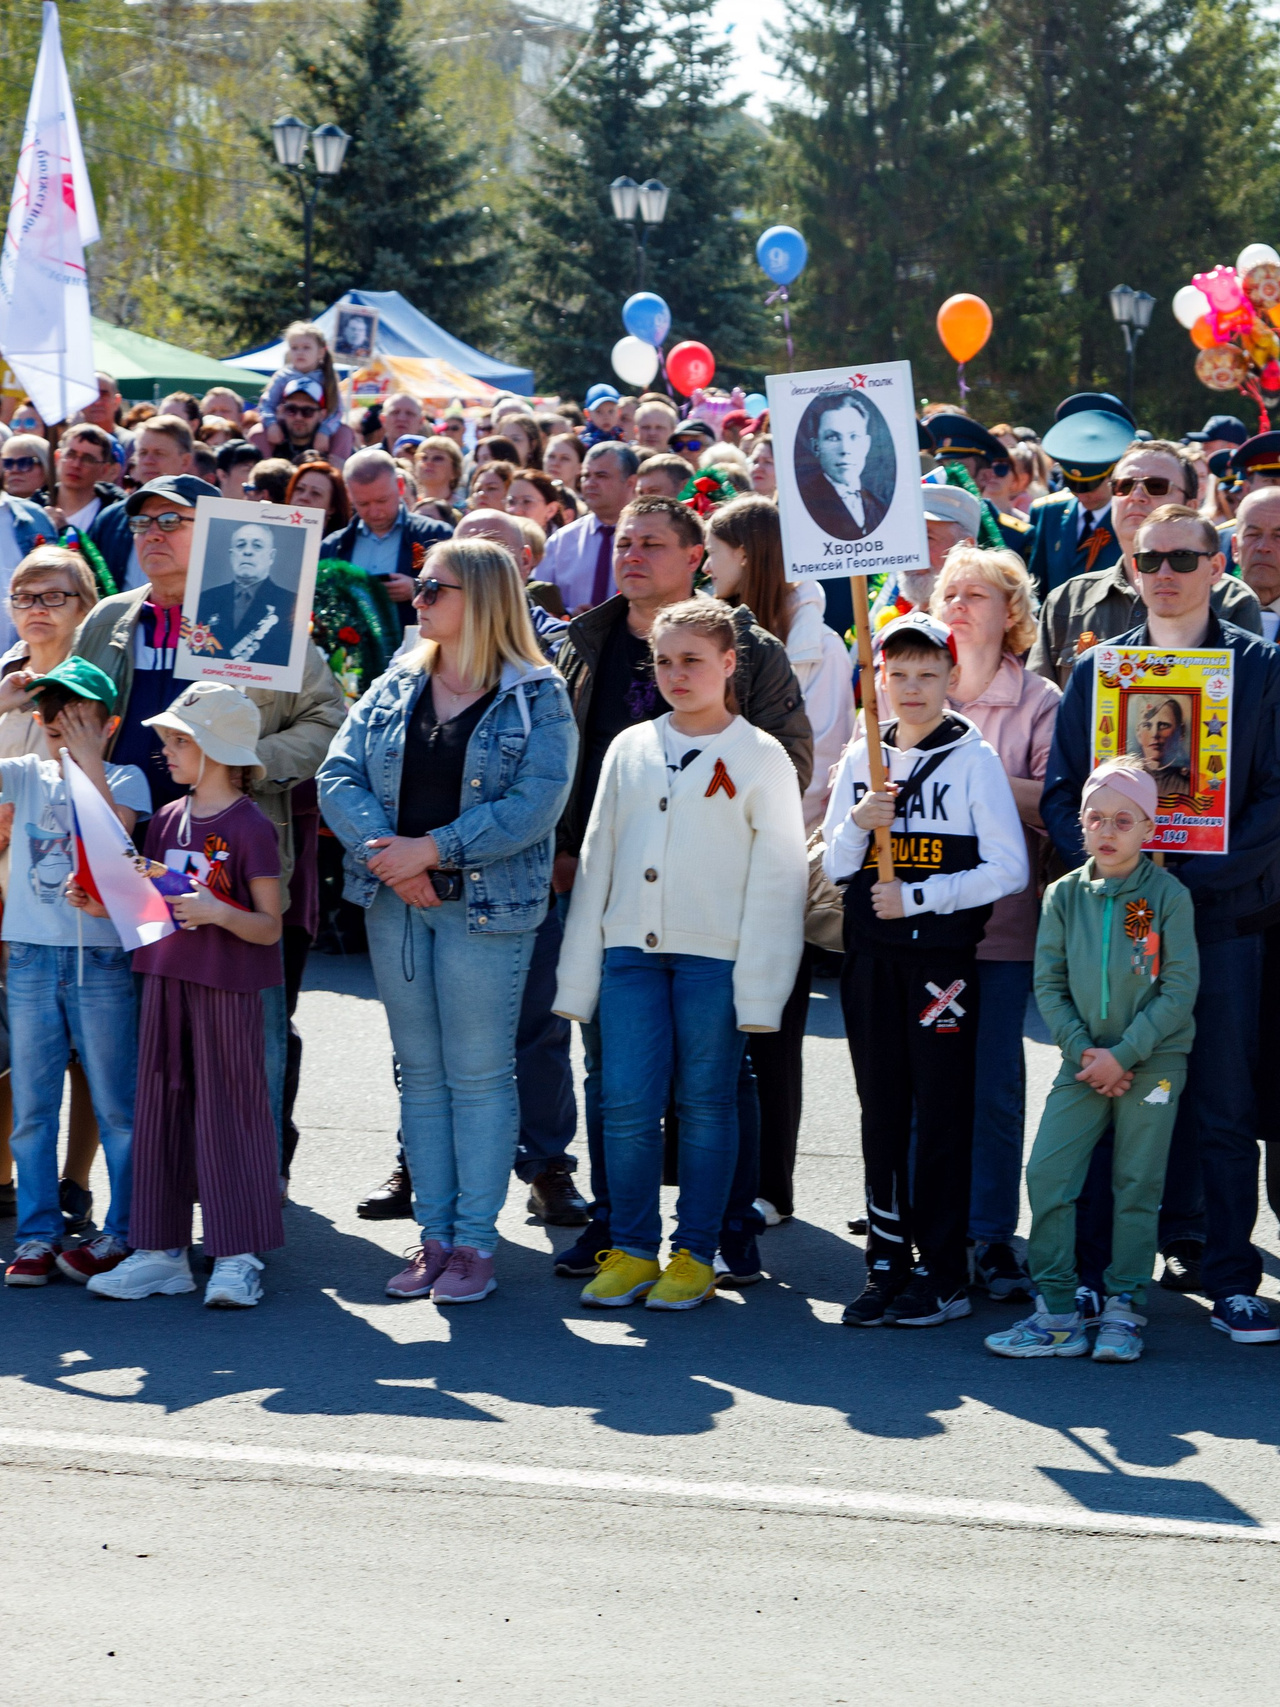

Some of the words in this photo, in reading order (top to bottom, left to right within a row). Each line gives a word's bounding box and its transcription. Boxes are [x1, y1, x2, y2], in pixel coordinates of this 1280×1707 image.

[823, 540, 884, 557] Хворов
[791, 558, 844, 574] Алексей
[846, 553, 921, 569] Георгиевич
[1145, 653, 1228, 668] Бессмертный
[1162, 829, 1188, 843] 1948
